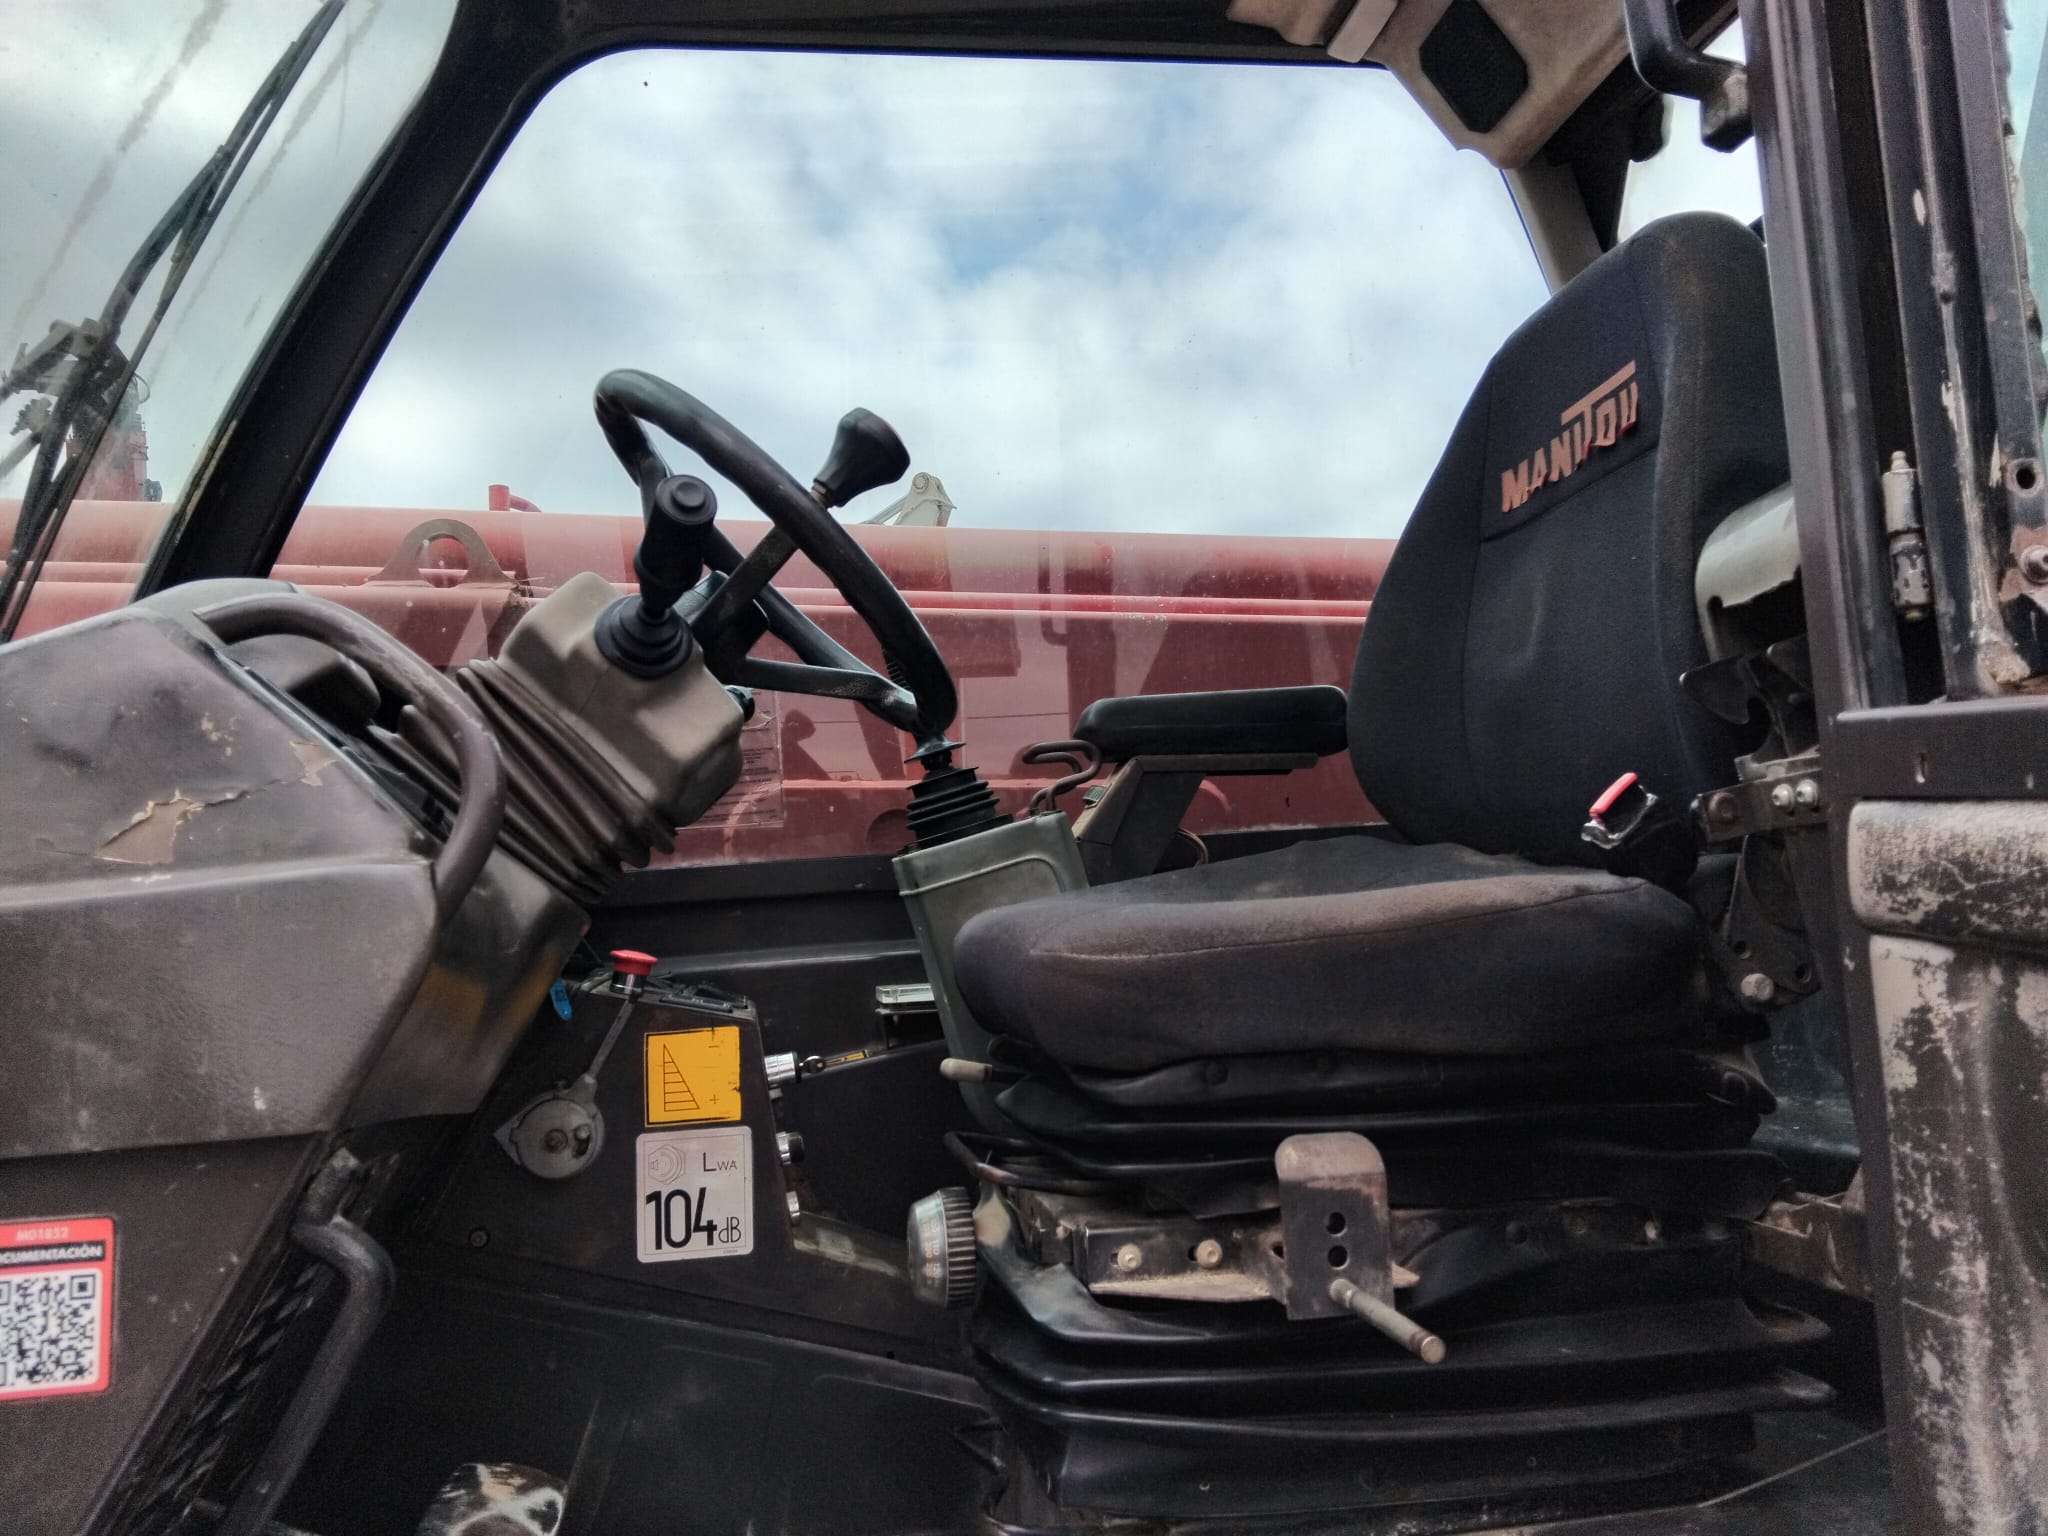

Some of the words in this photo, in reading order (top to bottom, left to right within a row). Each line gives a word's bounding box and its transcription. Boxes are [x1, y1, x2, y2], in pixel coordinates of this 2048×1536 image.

[1501, 359, 1639, 512] MANITOU
[645, 1187, 718, 1250] 104
[718, 1216, 742, 1244] dB
[0, 1243, 103, 1265] CUMENTACIÓN
